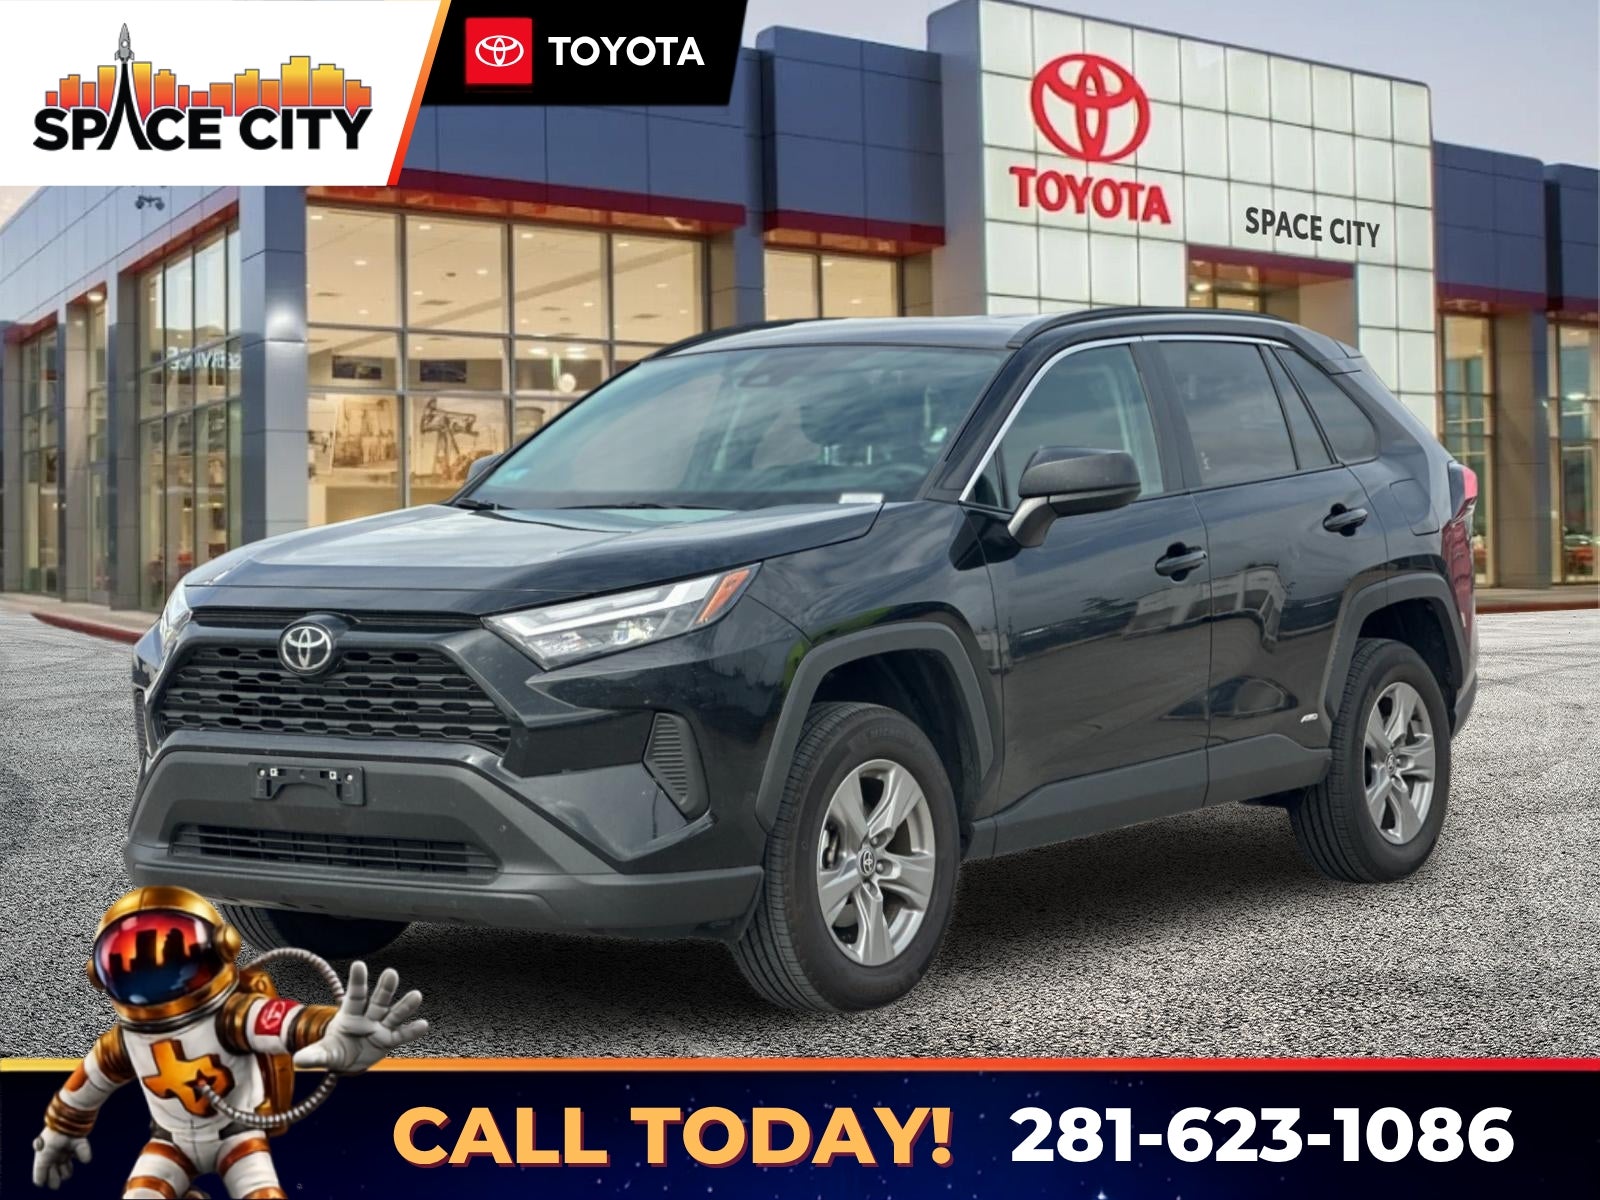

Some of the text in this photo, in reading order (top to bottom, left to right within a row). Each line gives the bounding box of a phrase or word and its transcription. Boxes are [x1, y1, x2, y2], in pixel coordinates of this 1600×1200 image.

[1009, 166, 1171, 225] TOYOTA
[1245, 206, 1380, 248] SPACE CITY
